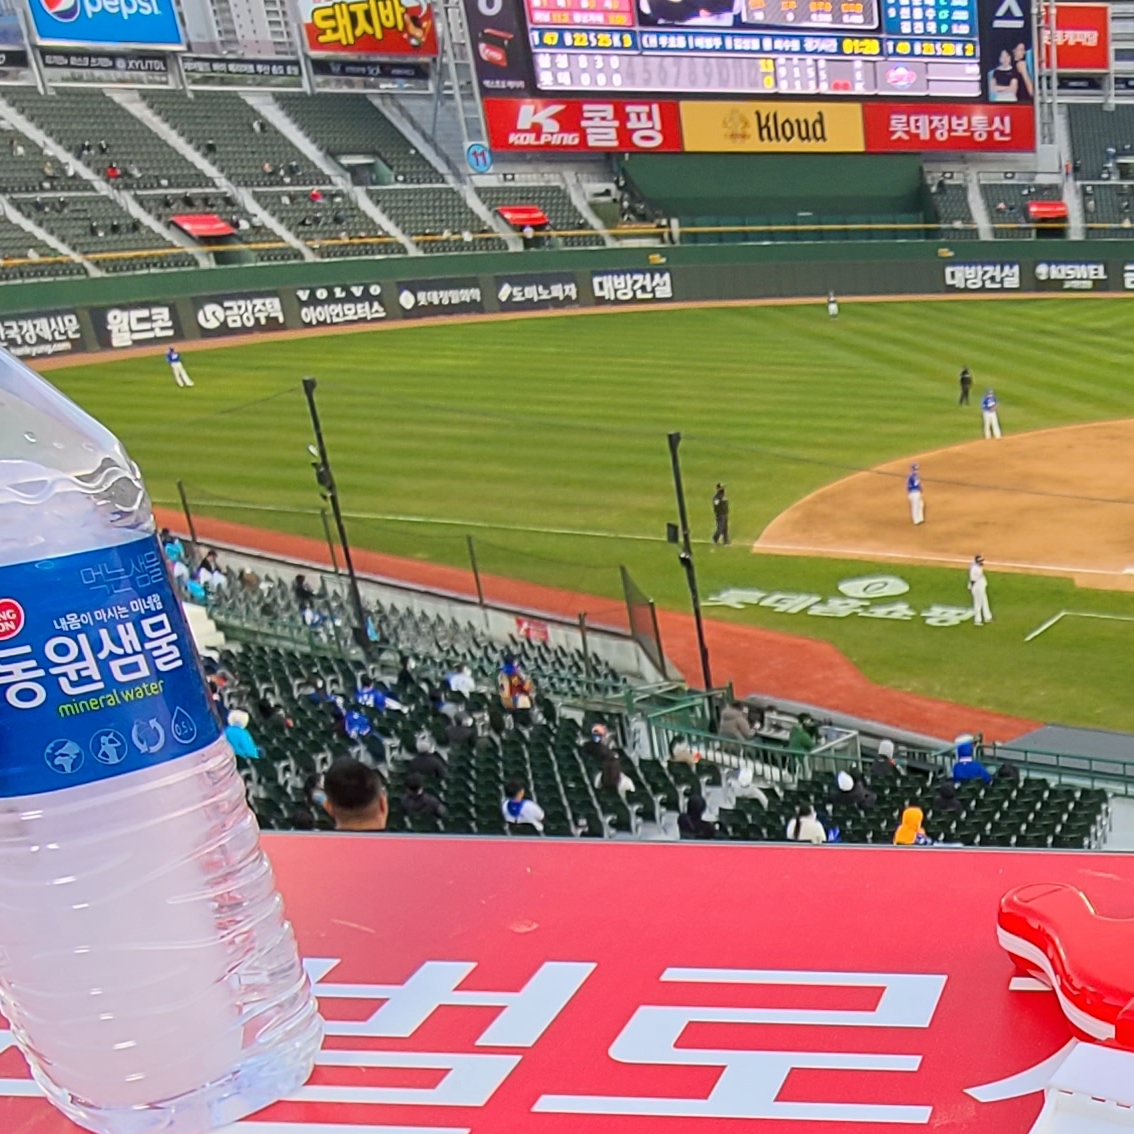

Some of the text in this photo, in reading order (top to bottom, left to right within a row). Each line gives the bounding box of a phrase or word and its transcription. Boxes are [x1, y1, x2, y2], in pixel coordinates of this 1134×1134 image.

[313, 0, 407, 45] 돼지바
[580, 103, 664, 148] 콜핑
[755, 110, 828, 143] Kloud
[888, 114, 1012, 142] 롯데정보통신
[592, 271, 673, 300] 대방건설
[944, 264, 1020, 289] 대방건설
[1050, 264, 1107, 280] KISWEL
[297, 284, 382, 301] VOLVO
[512, 283, 577, 302] 도미노피자
[107, 307, 174, 348] 월드콘
[223, 297, 285, 328] 금강주택
[301, 300, 387, 326] 아이언모터스
[80, 551, 164, 595] 먹는샘물
[53, 593, 163, 632] 내몸이 마시는 미네랄
[0, 613, 183, 709] 동원샘물
[58, 679, 165, 718] mineral water
